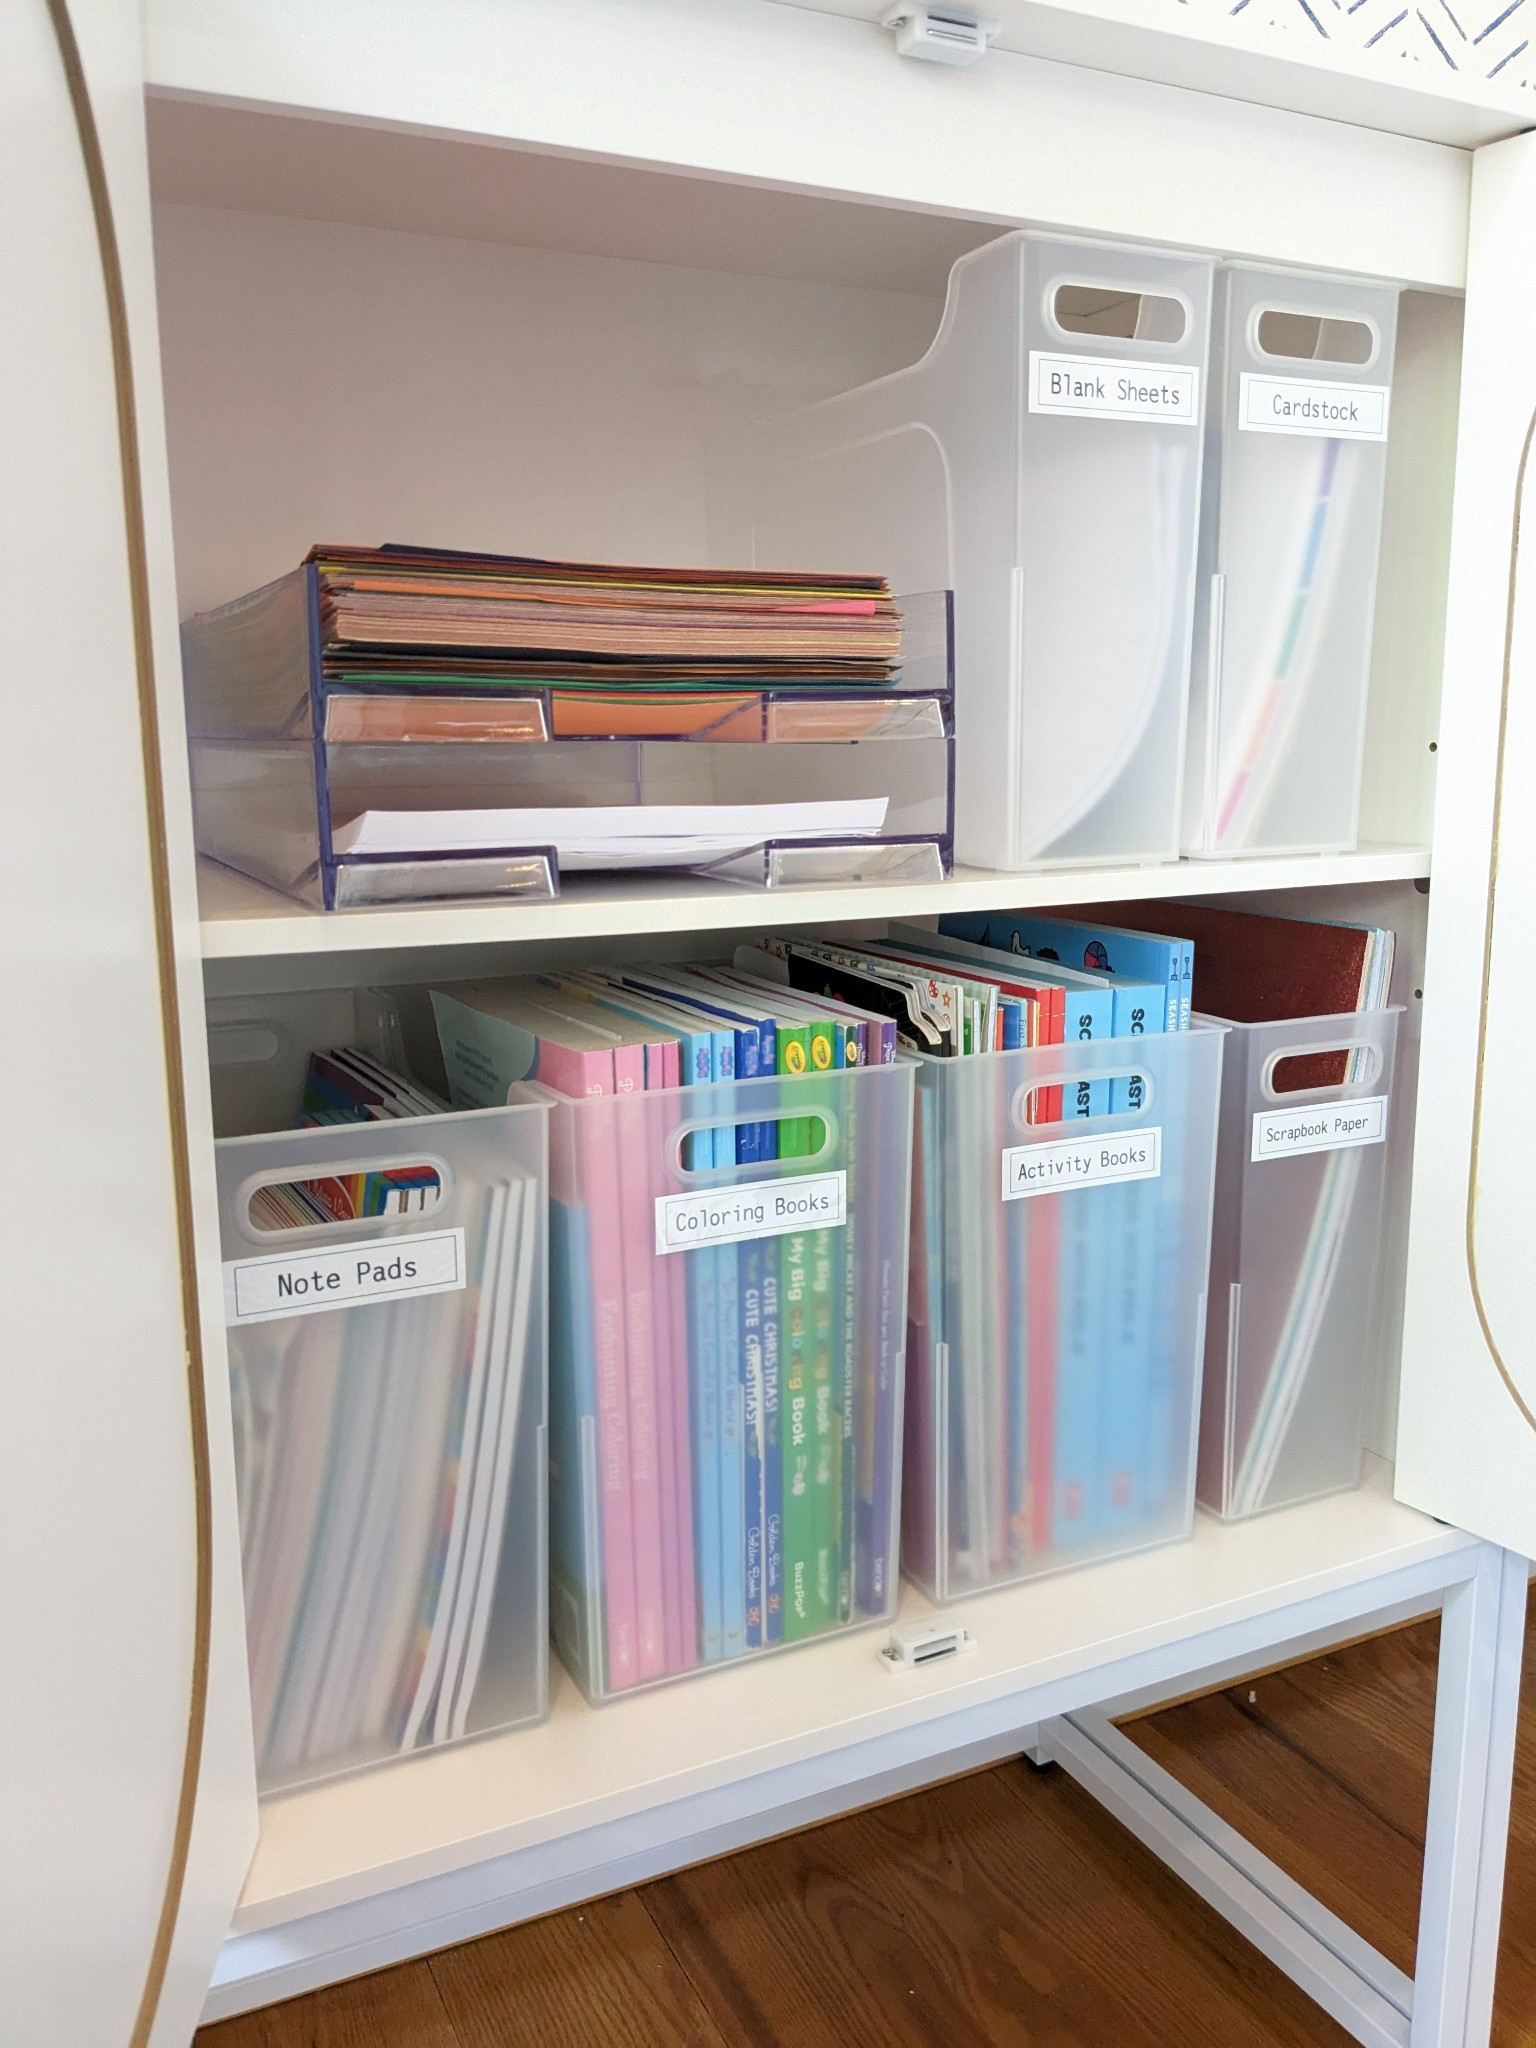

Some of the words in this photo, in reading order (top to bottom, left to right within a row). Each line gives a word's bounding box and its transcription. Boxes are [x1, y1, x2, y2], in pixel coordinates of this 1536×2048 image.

[1050, 372, 1106, 399] Blank
[1117, 378, 1180, 405] Sheets
[1272, 393, 1359, 422] Cardstock
[1180, 997, 1189, 1031] SEASH
[1266, 1120, 1328, 1143] Scrapbook
[1334, 1117, 1369, 1132] Paper
[1017, 1154, 1092, 1181] Activity
[1100, 1147, 1146, 1168] Books
[675, 1204, 765, 1232] Coloring
[775, 1193, 829, 1215] Books
[788, 1237, 804, 1263] My
[276, 1271, 342, 1298] Note
[356, 1256, 417, 1284] Pads
[788, 1268, 805, 1301] Big
[745, 1289, 759, 1327] CUTE
[764, 1277, 777, 1315] CUTE
[764, 1323, 779, 1413] CHRISTMAS!
[792, 1397, 806, 1445] Book
